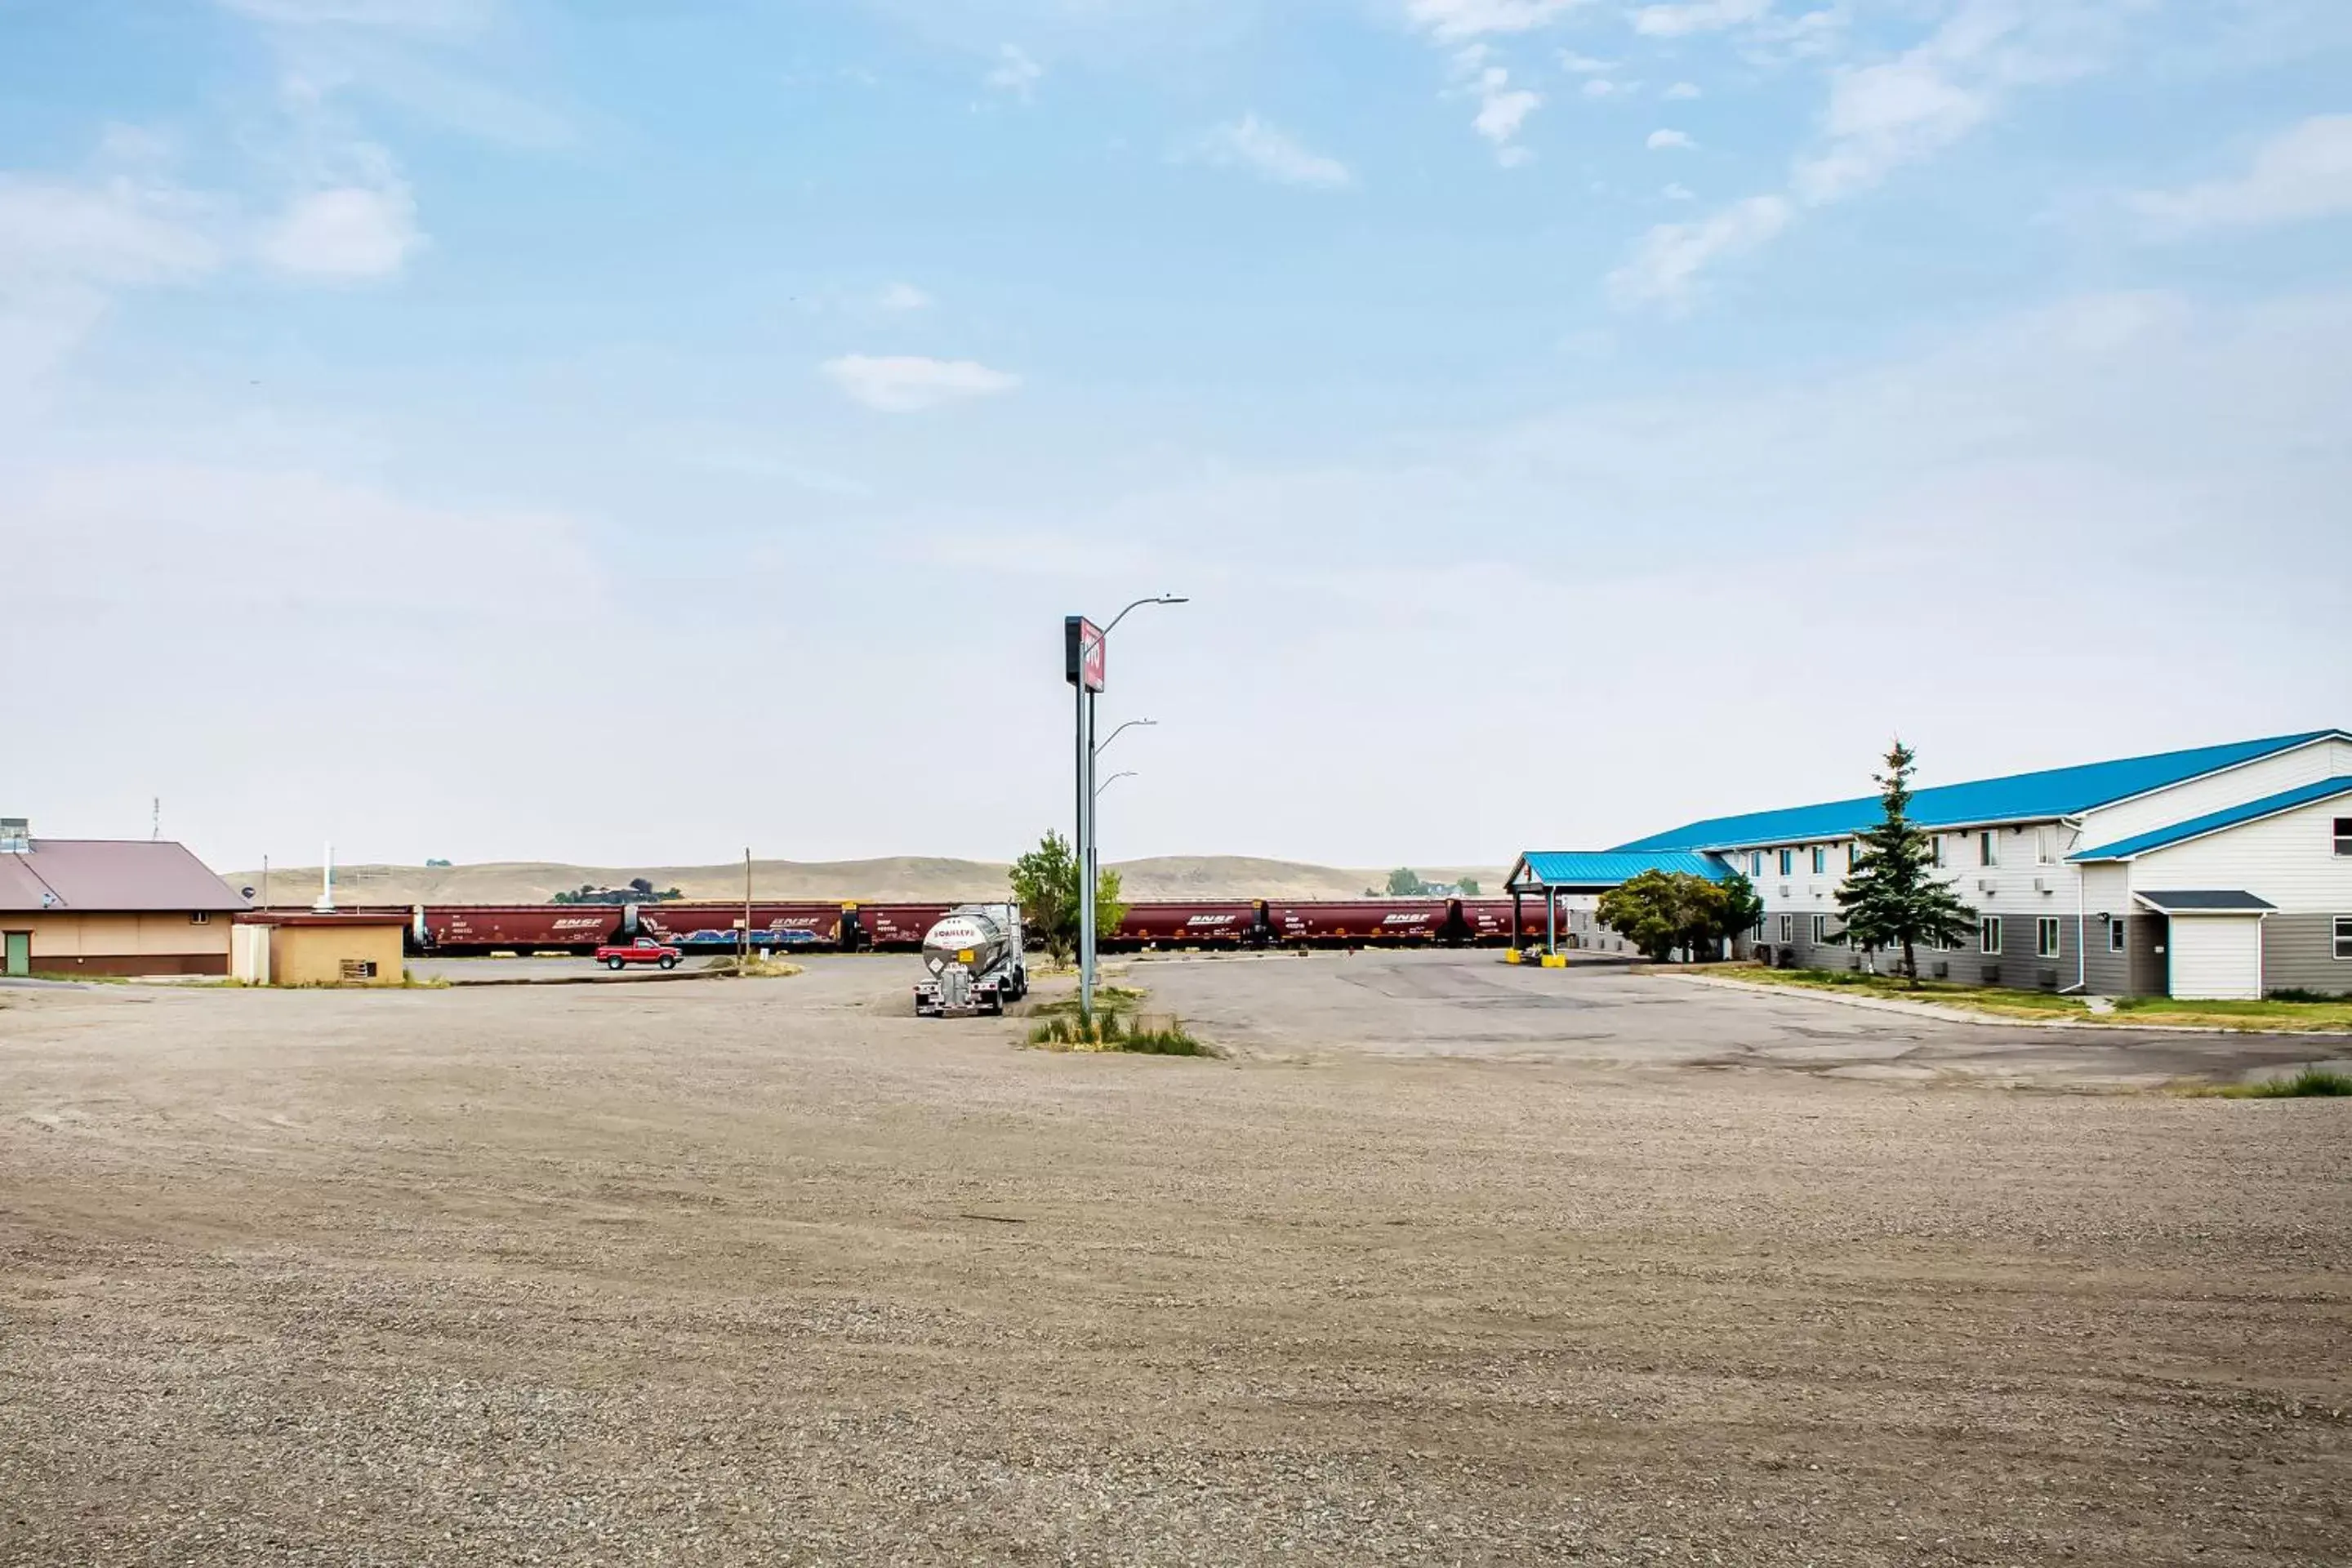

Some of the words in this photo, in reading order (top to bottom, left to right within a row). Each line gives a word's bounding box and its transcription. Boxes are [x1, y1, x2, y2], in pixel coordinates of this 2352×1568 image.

[552, 918, 603, 929] BNSF
[769, 917, 819, 927] BNSF
[1187, 915, 1236, 925] BNSF
[1382, 913, 1431, 924] BNSF
